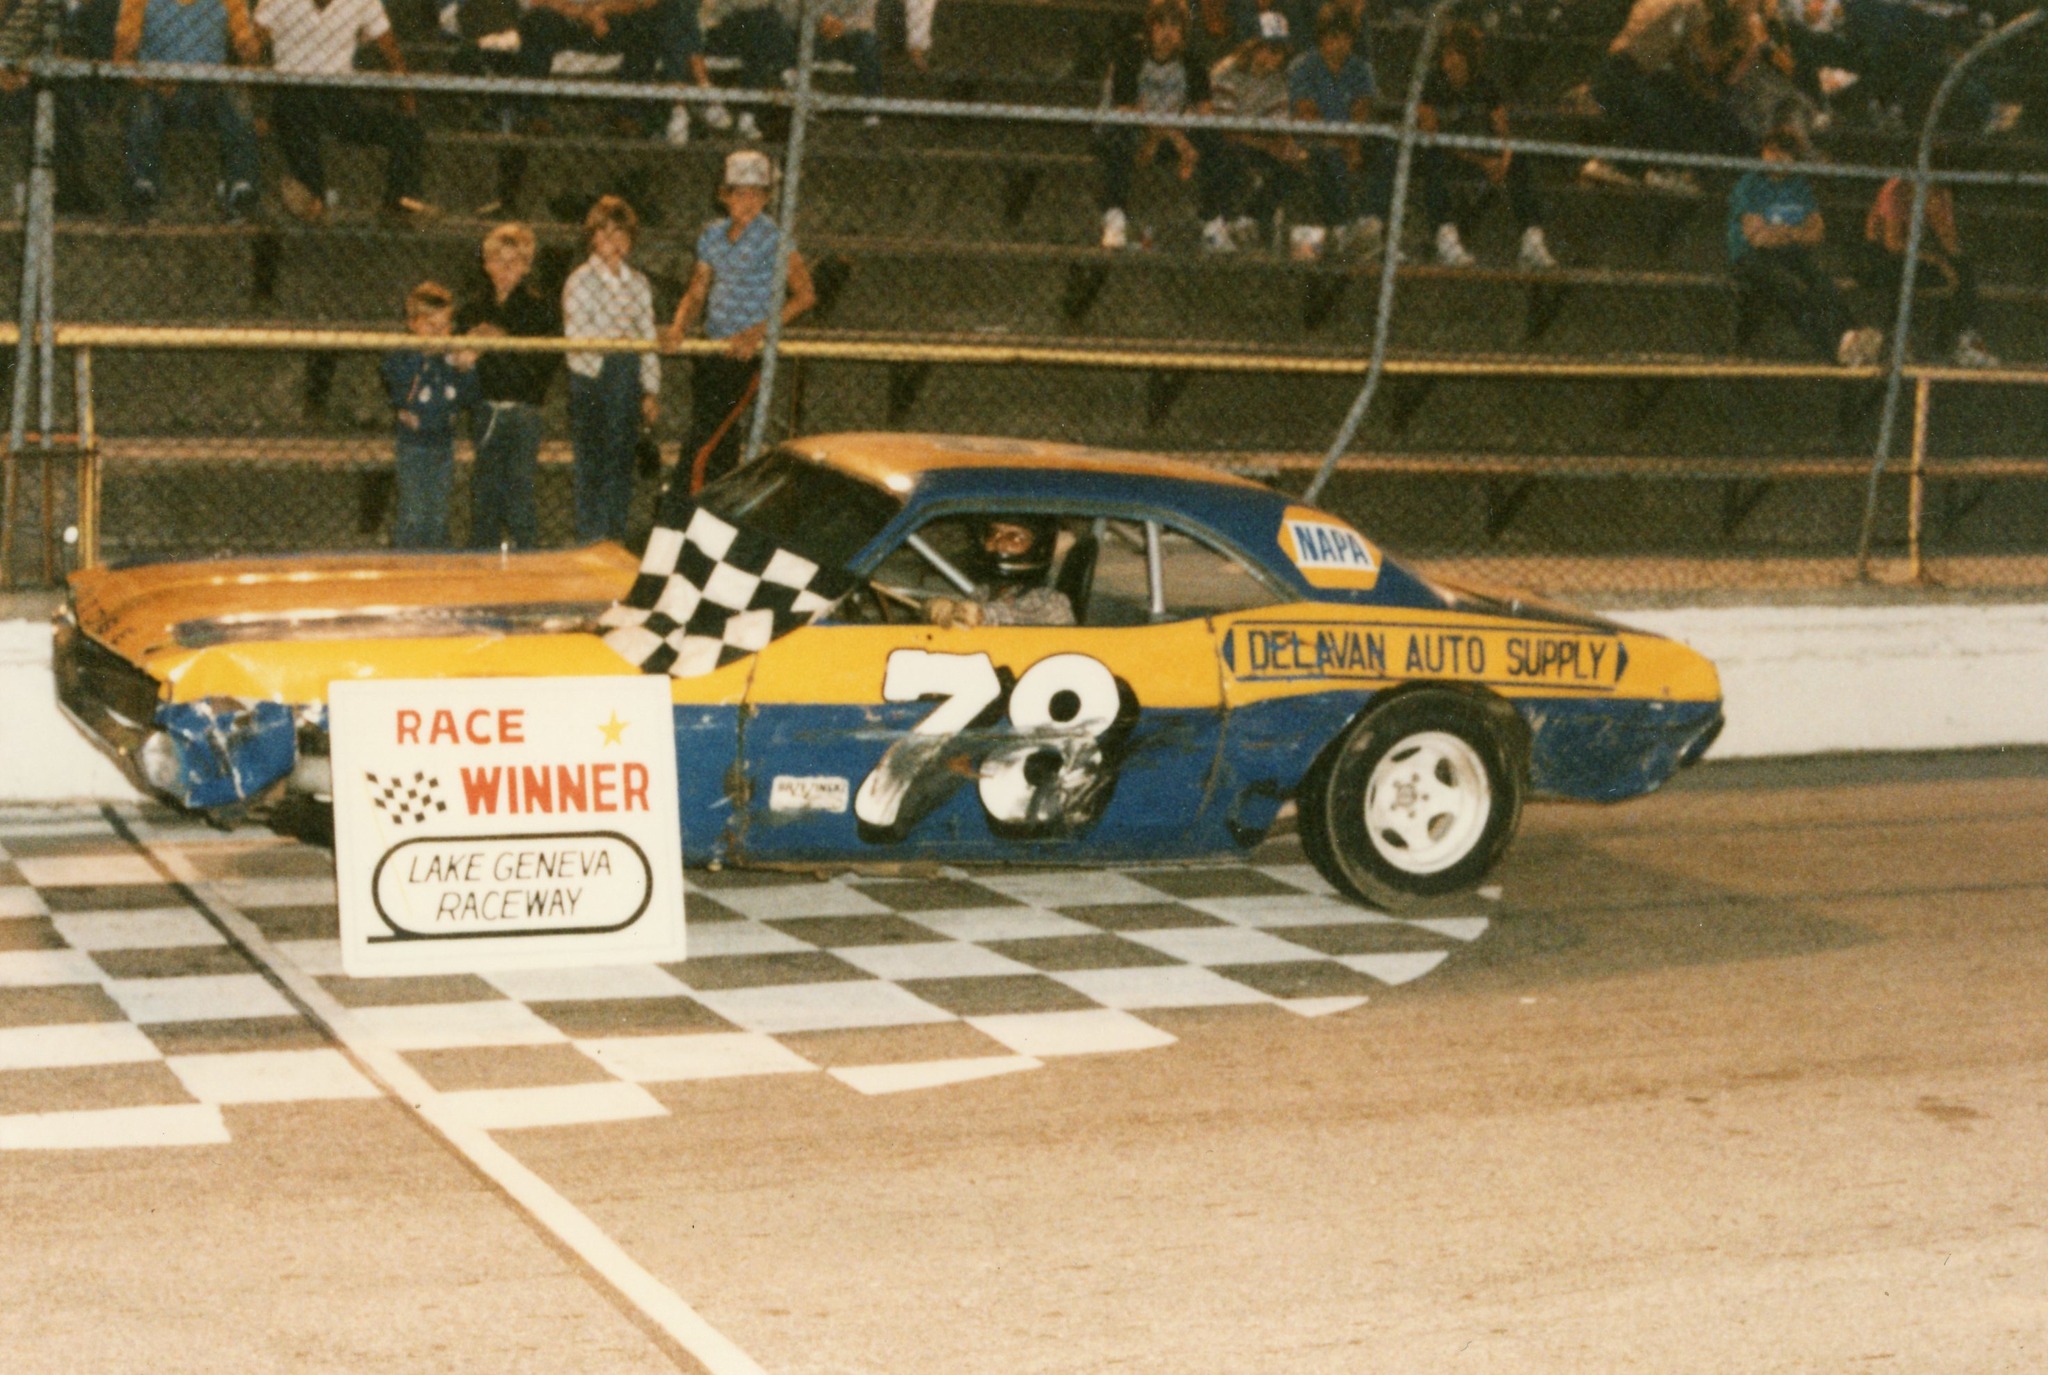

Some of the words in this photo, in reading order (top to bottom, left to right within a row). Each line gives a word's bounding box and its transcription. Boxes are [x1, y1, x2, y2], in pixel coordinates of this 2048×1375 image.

[1295, 526, 1369, 564] NAPA
[1248, 630, 1386, 672] DELAVAN
[1406, 633, 1486, 674] AUTO
[1507, 637, 1607, 680] SUPPLY
[396, 708, 525, 744] RACE
[854, 648, 1121, 827] 78
[460, 762, 650, 815] WINNER
[408, 853, 486, 883] LAKE
[494, 850, 612, 881] GENEVA
[436, 887, 583, 922] RACEWAY
